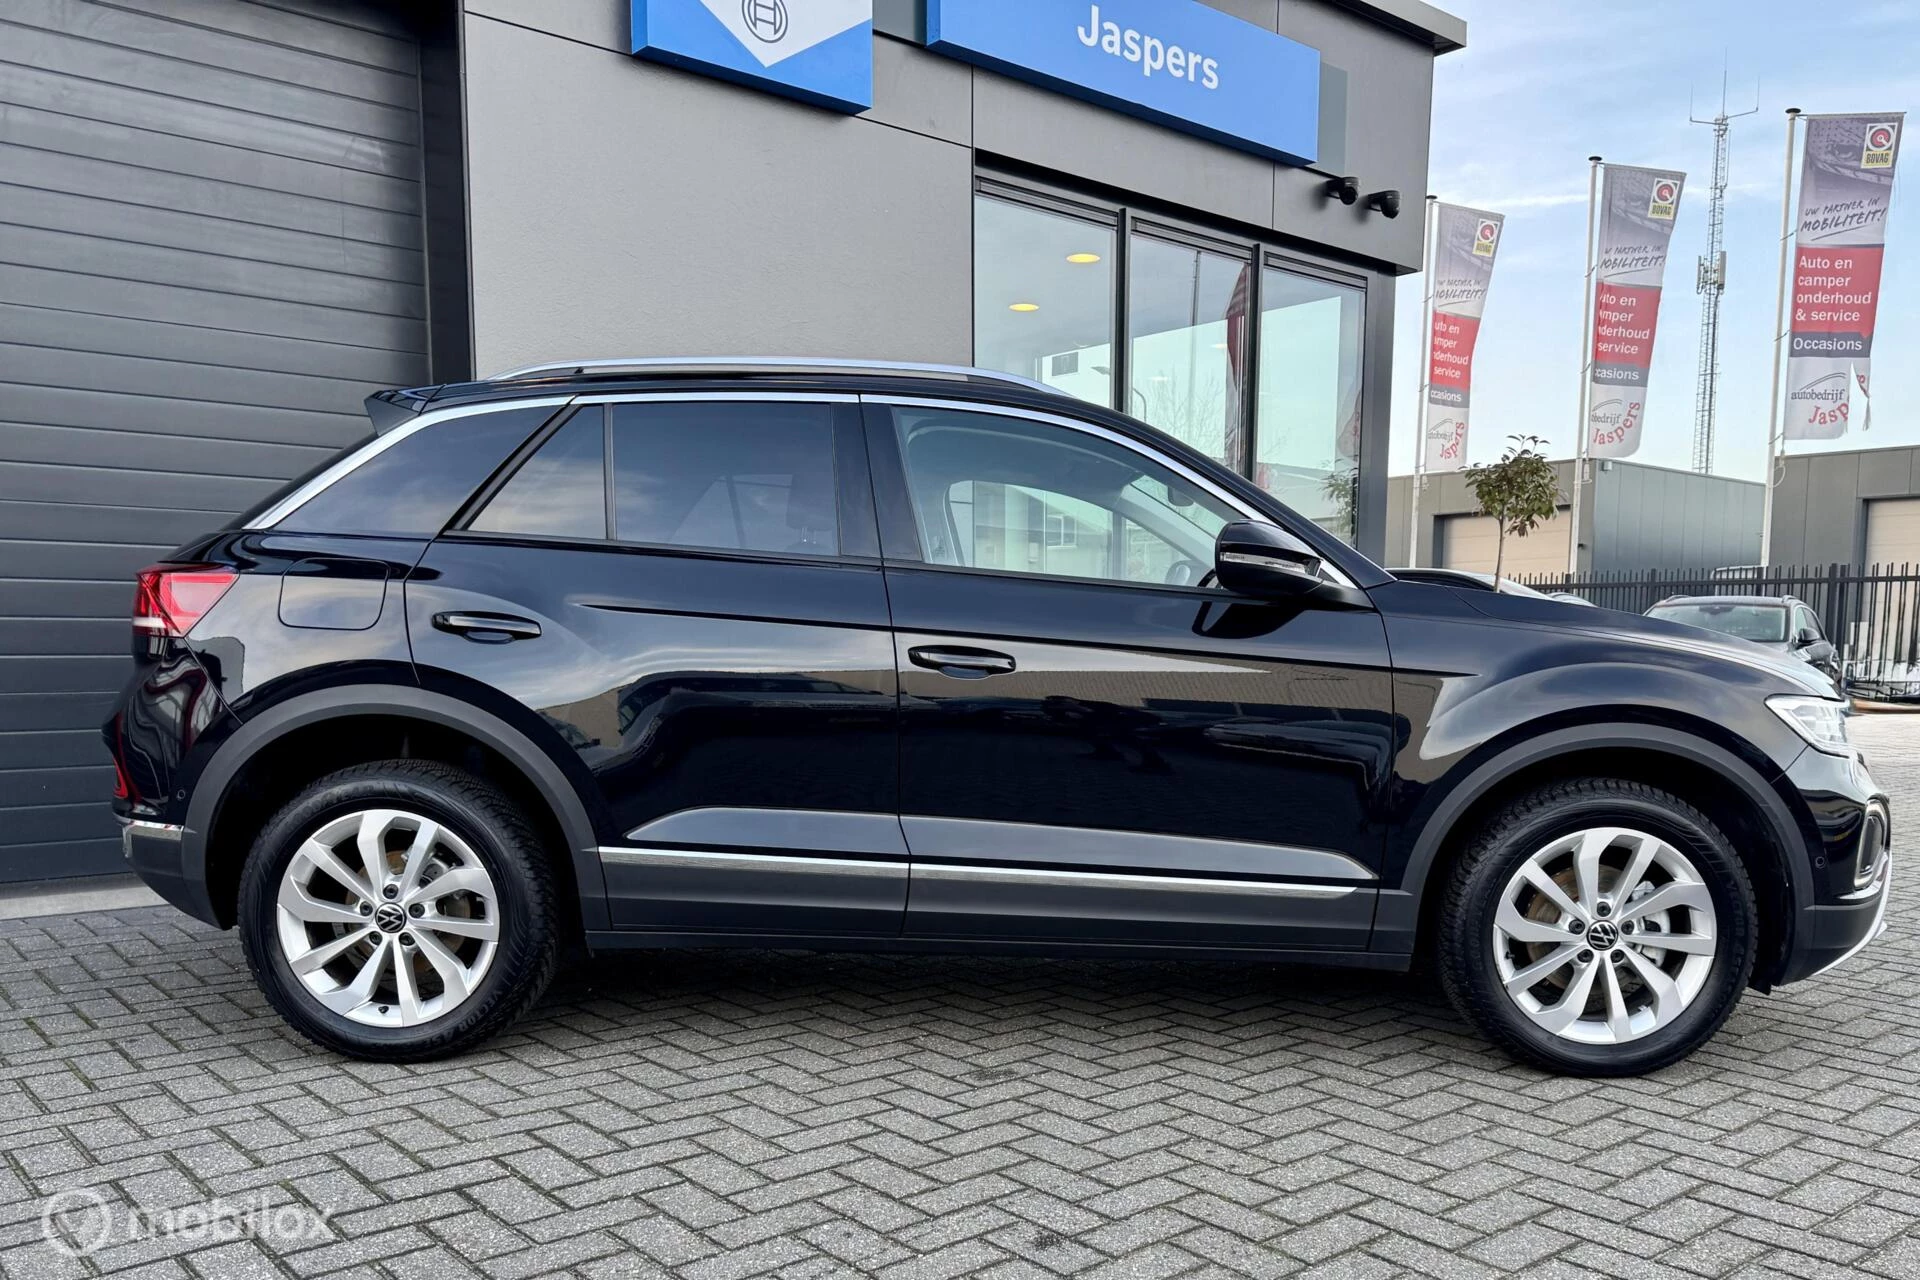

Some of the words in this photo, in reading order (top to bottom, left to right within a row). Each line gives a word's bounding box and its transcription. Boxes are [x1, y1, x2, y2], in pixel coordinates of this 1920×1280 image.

[1077, 4, 1219, 90] Jaspers
[1866, 152, 1889, 164] BOVAG
[1805, 208, 1820, 217] UW
[1823, 200, 1864, 215] PARTNER
[1868, 197, 1880, 206] IN
[1801, 207, 1887, 232] MOBILITEIT!
[1799, 256, 1830, 269] Auto
[1834, 258, 1853, 269] en
[1798, 276, 1851, 289] camper
[1600, 293, 1616, 305] uto
[1619, 296, 1637, 306] en
[1796, 292, 1872, 304] onderhoud
[1599, 309, 1634, 323] mper
[1795, 308, 1806, 321] &
[1811, 309, 1861, 322] service
[1598, 325, 1650, 339] derhoud
[1597, 342, 1639, 355] service
[1793, 337, 1863, 351] Occasions
[1433, 351, 1469, 365] derhoud
[1791, 389, 1846, 404] autobedrijf
